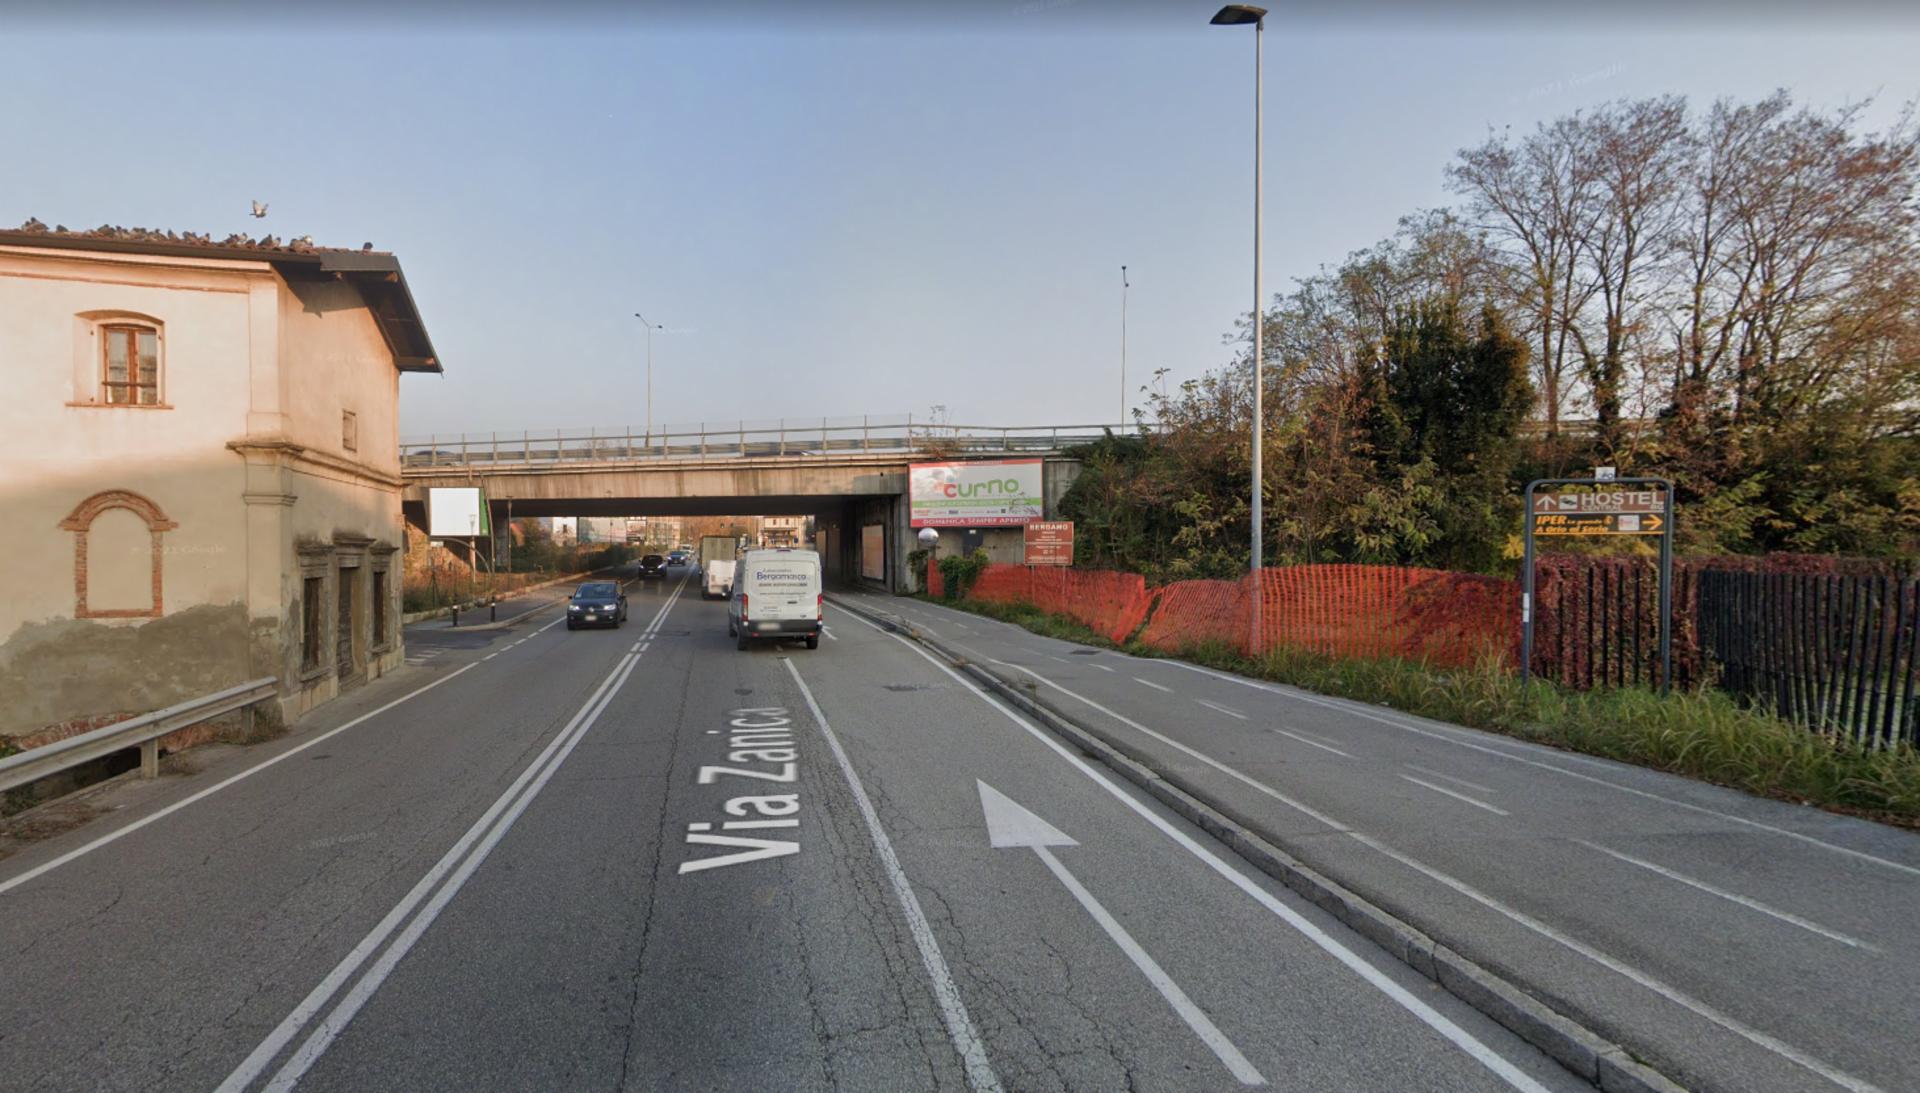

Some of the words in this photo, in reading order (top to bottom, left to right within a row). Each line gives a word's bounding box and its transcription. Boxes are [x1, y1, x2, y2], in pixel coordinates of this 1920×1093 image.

[943, 478, 1019, 498] curno
[1581, 491, 1664, 506] HOSTEL
[1582, 504, 1622, 512] CENTRAL
[1000, 516, 1031, 524] APERTO
[1536, 515, 1567, 525] IPER
[1029, 523, 1069, 531] BERGAMO
[1545, 525, 1567, 533] Orio
[1582, 525, 1608, 533] Serio
